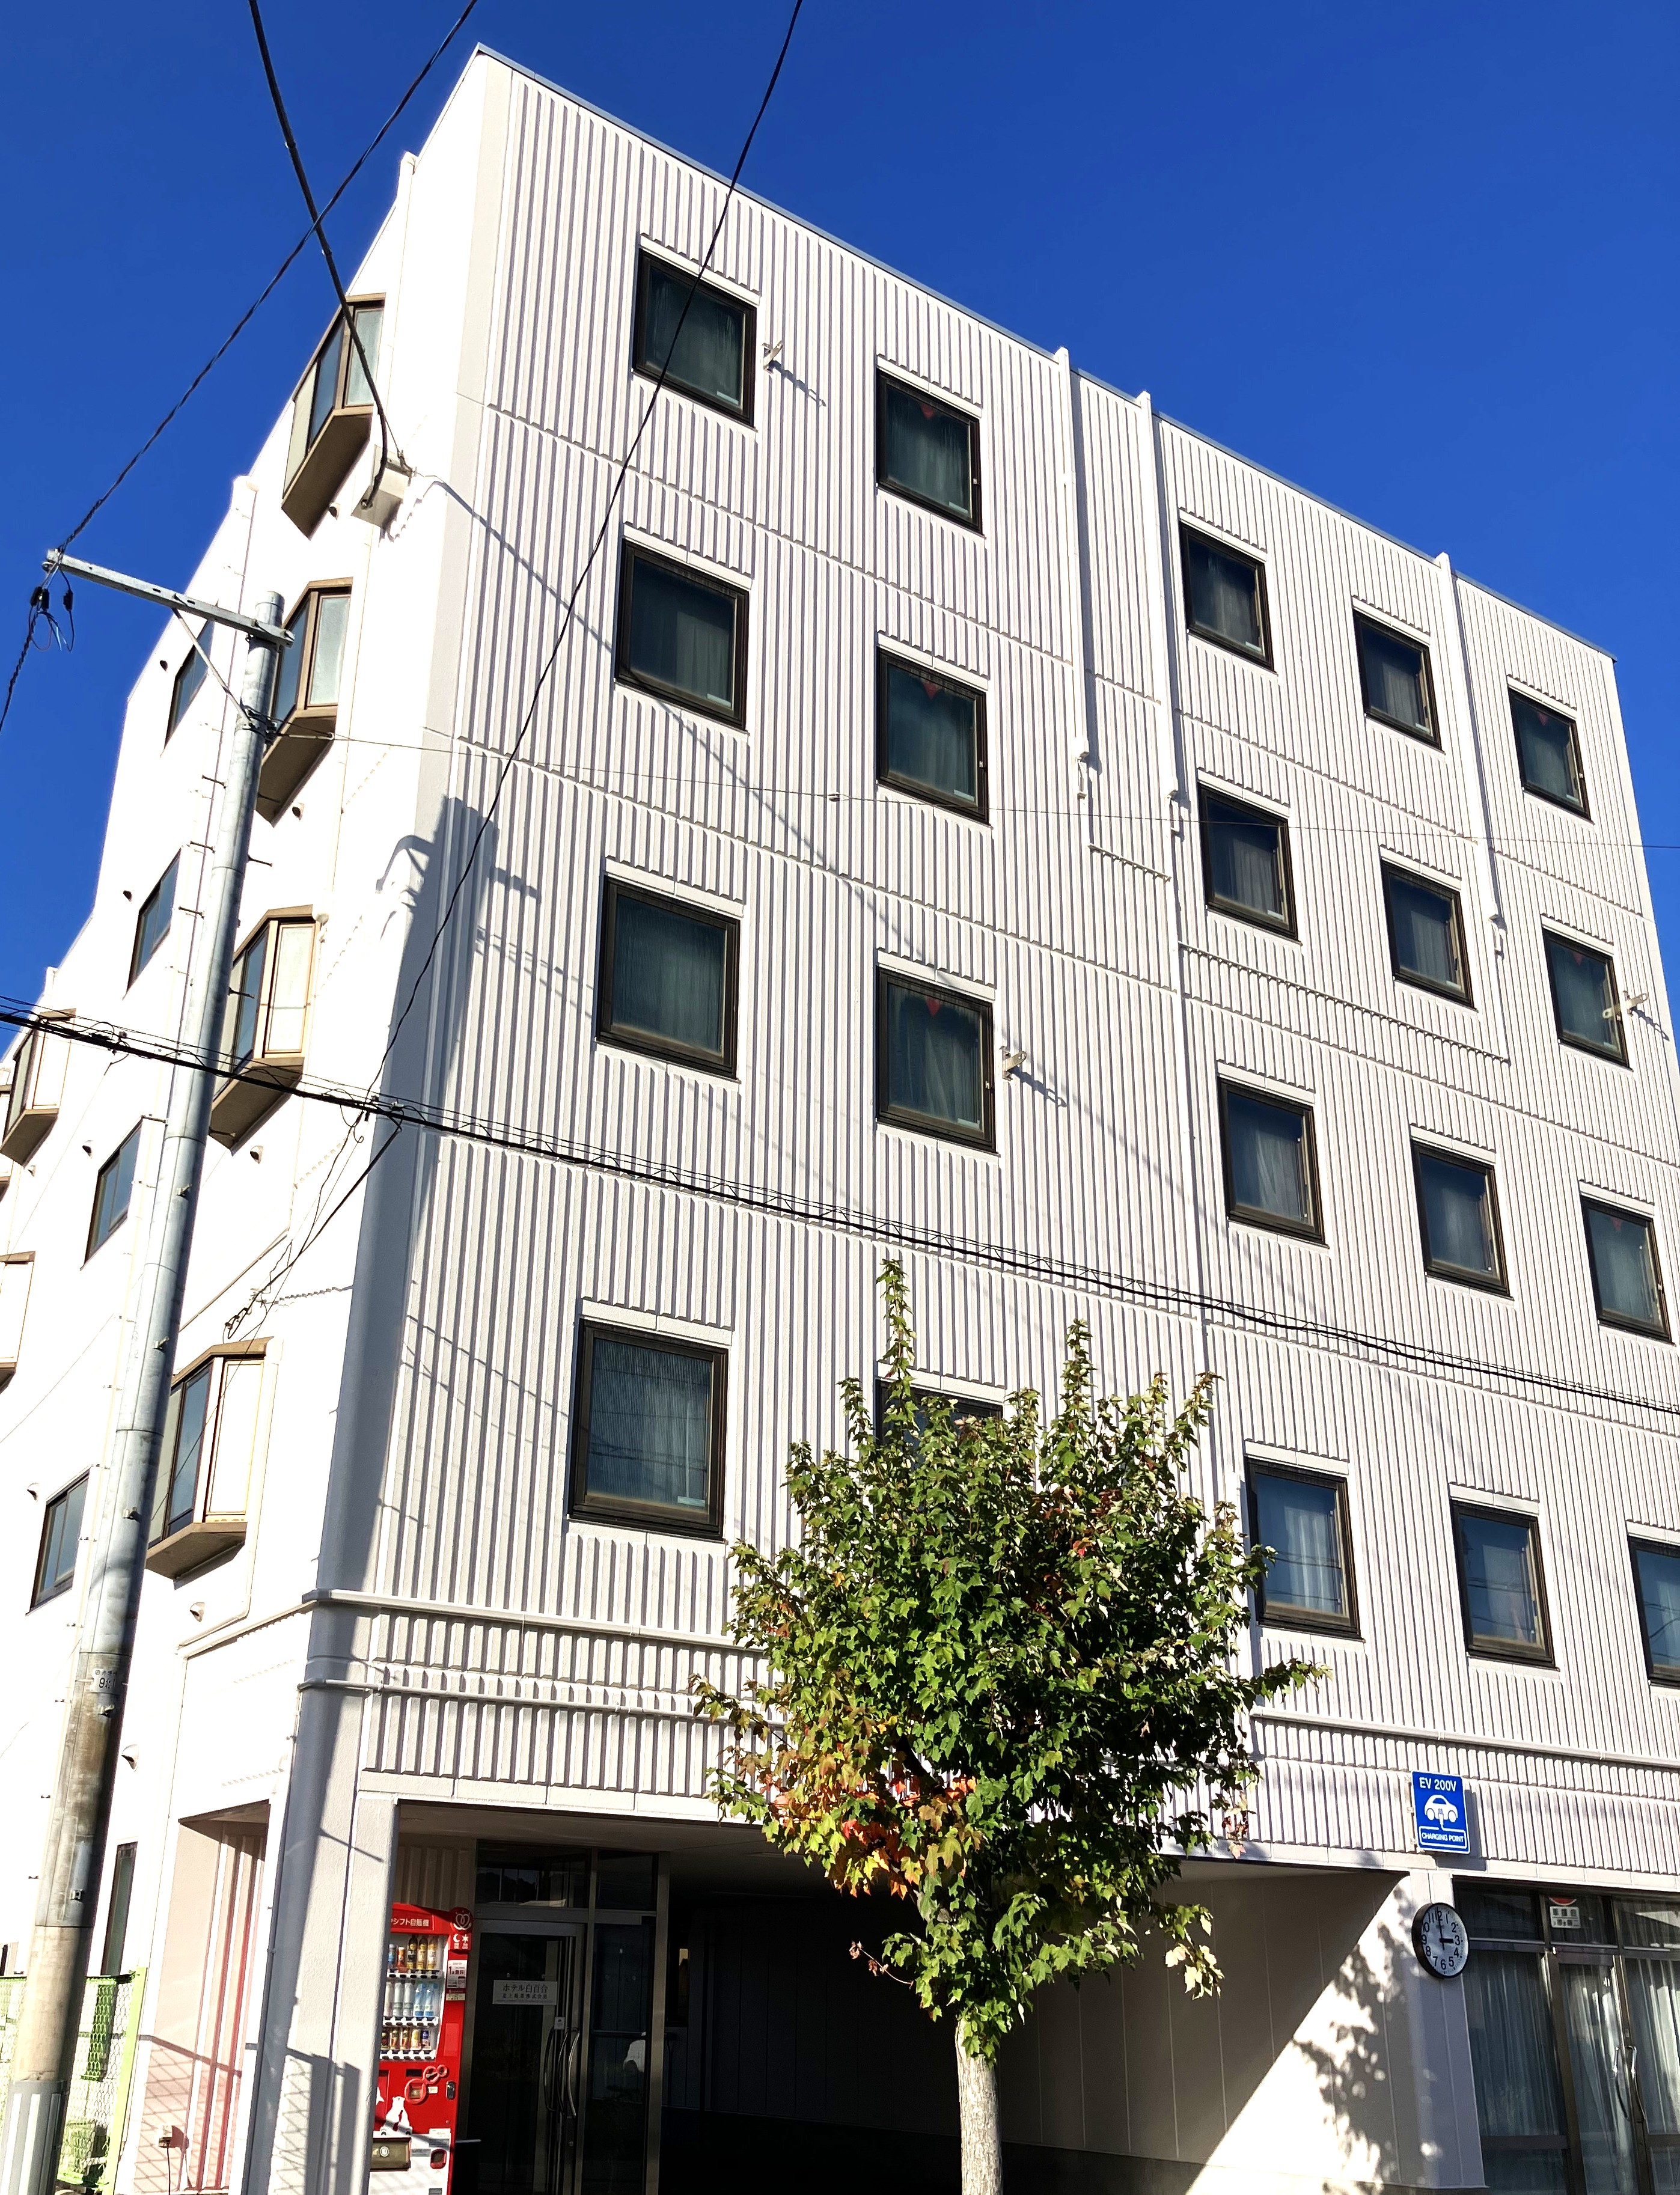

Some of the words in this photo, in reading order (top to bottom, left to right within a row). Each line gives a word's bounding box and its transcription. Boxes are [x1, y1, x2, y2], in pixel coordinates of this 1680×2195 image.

[1419, 1777, 1432, 1789] EV
[1434, 1779, 1456, 1792] 200V
[1422, 1832, 1448, 1842] CHARGING
[1449, 1834, 1464, 1843] POINT
[1451, 1922, 1457, 1933] 2
[1422, 1934, 1427, 1945] 9
[1455, 1935, 1461, 1946] 3
[1426, 1946, 1431, 1956] 8
[1453, 1947, 1459, 1958] 4
[1432, 1956, 1438, 1967] 7
[1440, 1959, 1446, 1970] 6
[1449, 1956, 1454, 1967] 5
